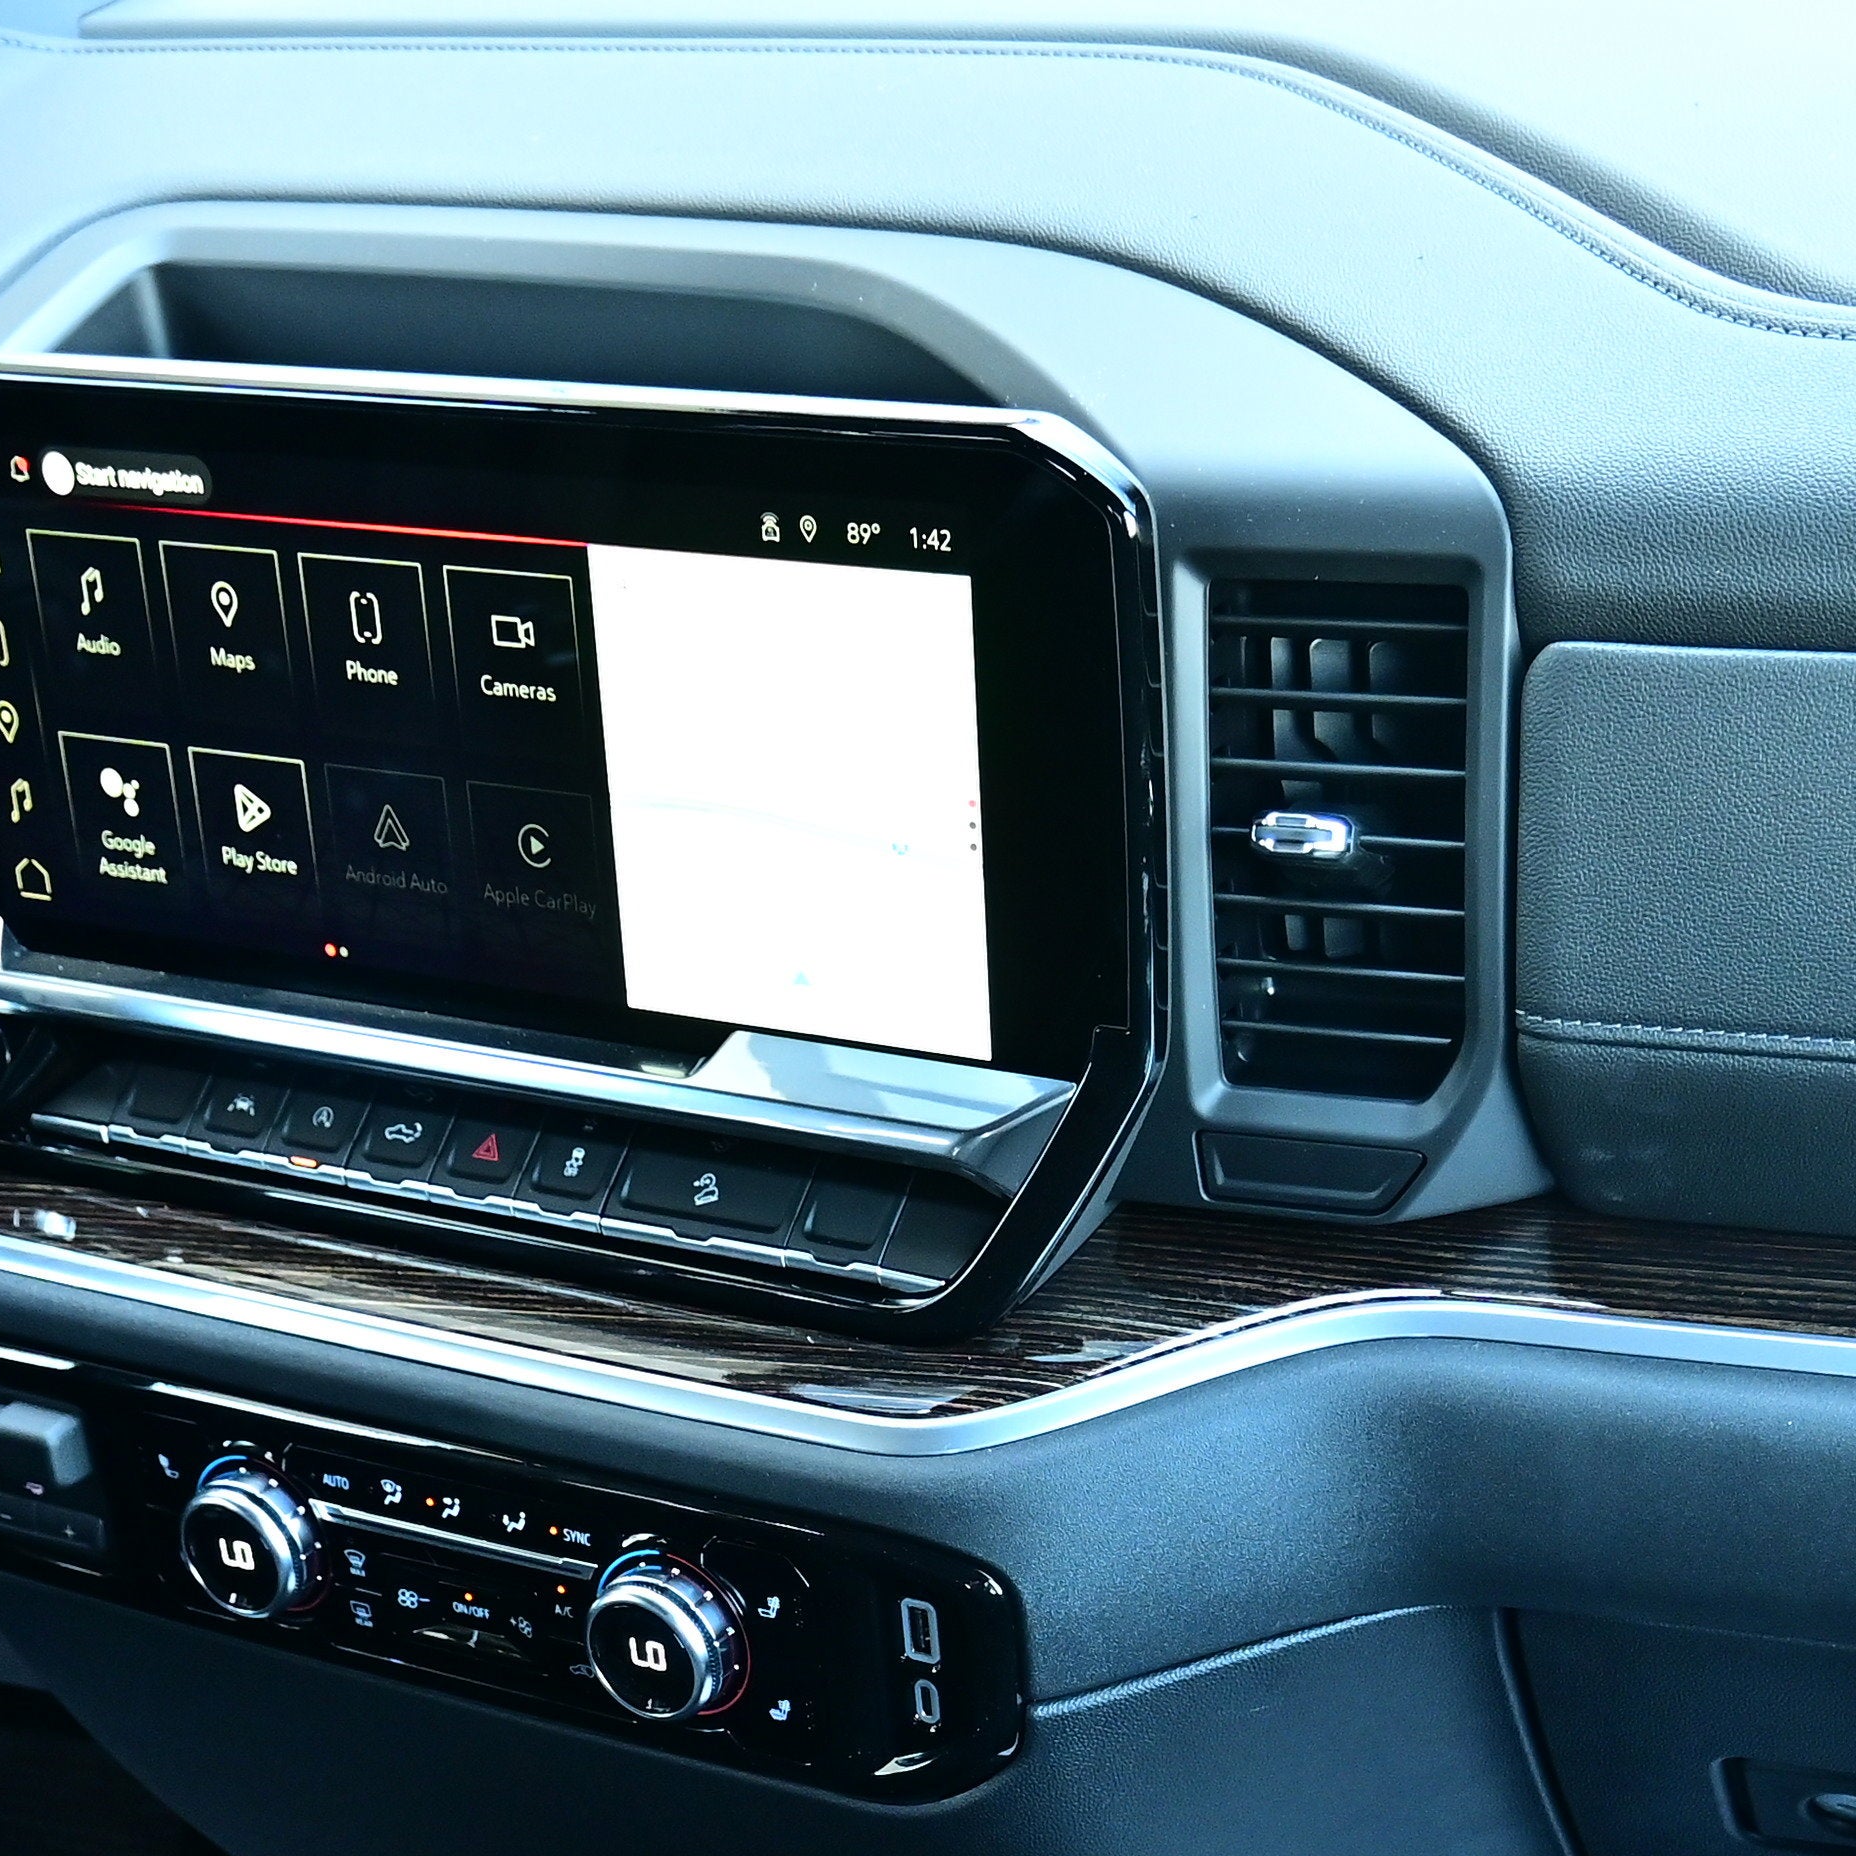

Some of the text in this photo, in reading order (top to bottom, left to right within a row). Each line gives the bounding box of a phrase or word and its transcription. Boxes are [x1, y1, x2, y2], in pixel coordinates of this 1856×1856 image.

[75, 461, 204, 496] Start navigation
[909, 526, 952, 551] 1:42
[76, 633, 121, 656] Audio
[210, 646, 255, 673] Maps
[345, 660, 398, 686] Phone
[480, 675, 557, 702] Cameras
[101, 829, 156, 859] Google
[99, 856, 168, 884] Assistant
[221, 845, 298, 875] Play Store
[345, 864, 448, 894] Android Auto
[483, 883, 596, 919] Apple CarPlay
[322, 1473, 350, 1490] AUTO
[563, 1528, 591, 1547] SYNC
[452, 1601, 490, 1619] ON/OFF
[554, 1604, 574, 1619] A/C
